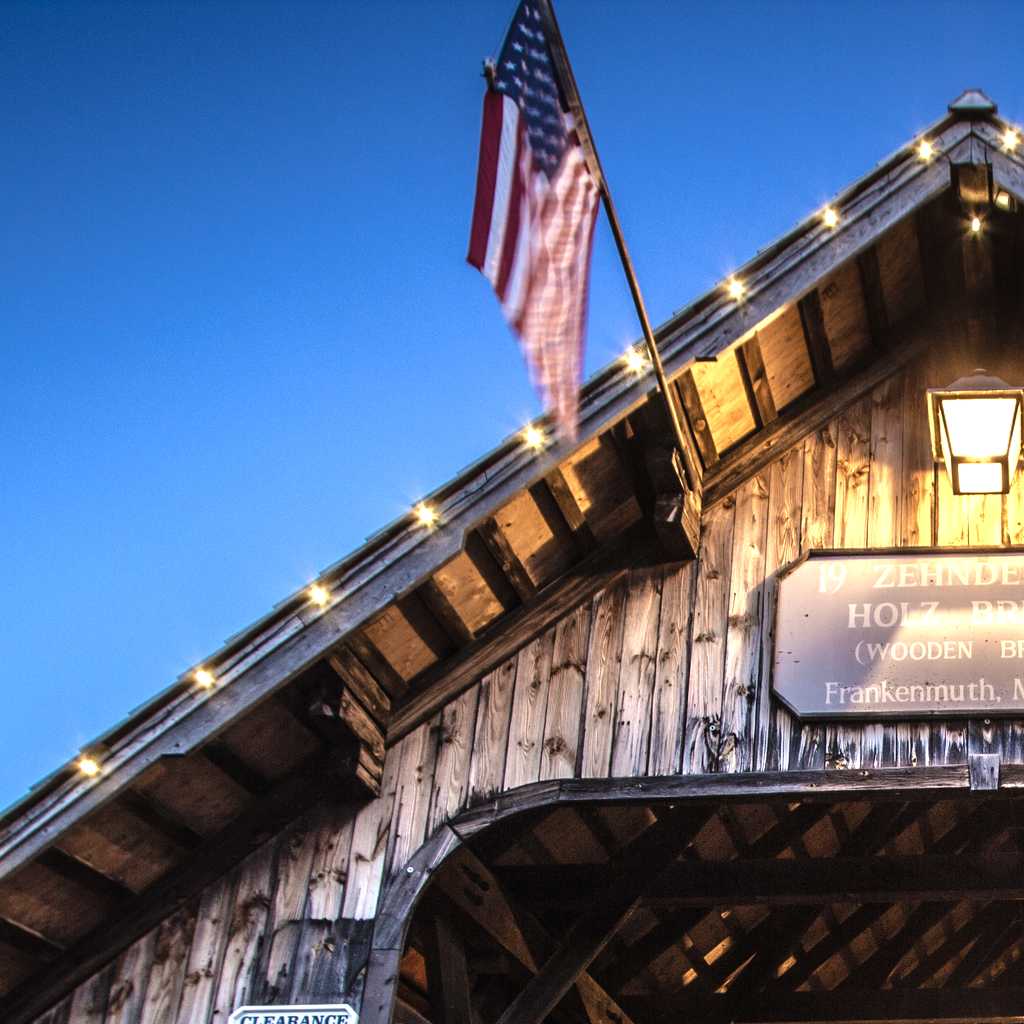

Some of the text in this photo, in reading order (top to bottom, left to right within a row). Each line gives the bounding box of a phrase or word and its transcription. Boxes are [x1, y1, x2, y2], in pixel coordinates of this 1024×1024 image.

[818, 563, 847, 593] 19
[847, 600, 941, 628] HOLZ
[855, 639, 973, 665] (WOODEN
[825, 680, 1001, 704] Frankenmuth,
